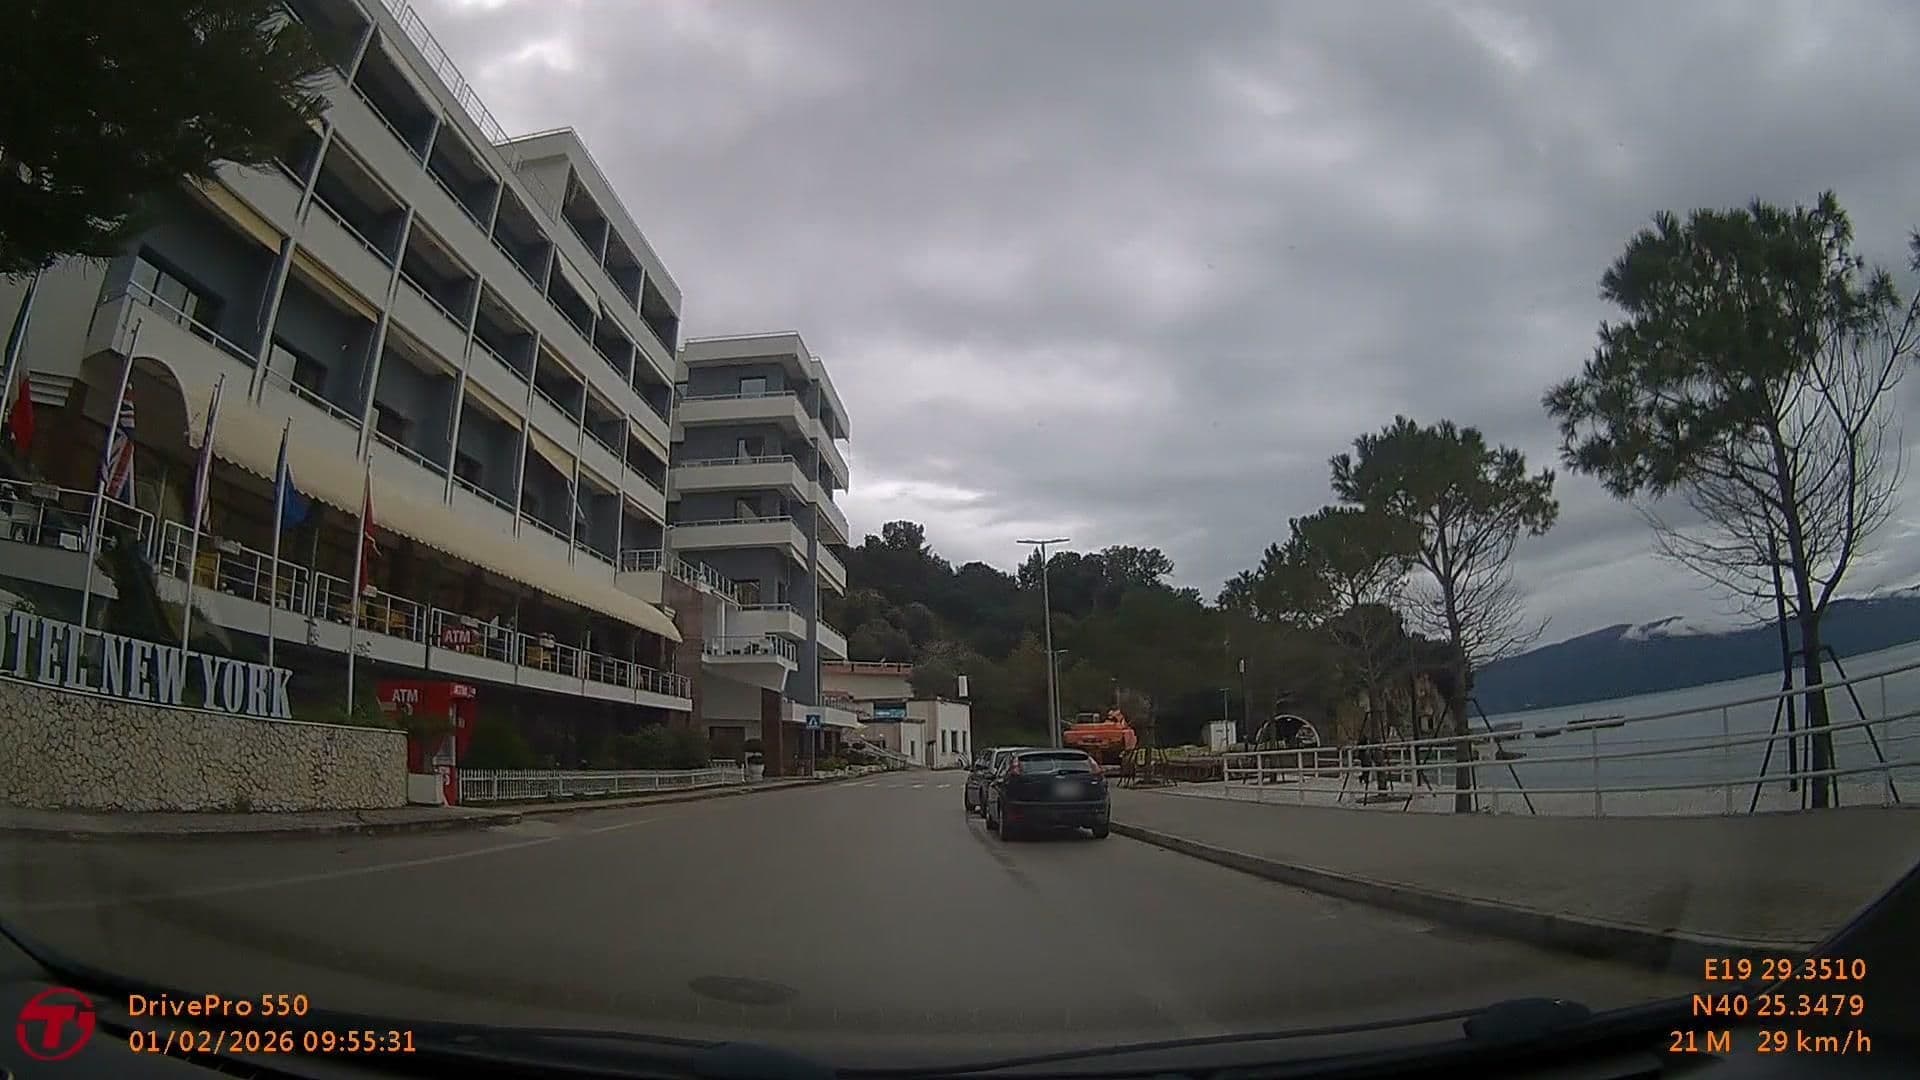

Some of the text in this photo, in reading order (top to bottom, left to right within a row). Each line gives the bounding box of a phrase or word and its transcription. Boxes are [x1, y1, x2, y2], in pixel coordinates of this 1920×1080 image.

[444, 629, 471, 643] ATM
[0, 609, 293, 719] TEL NEW YORK
[392, 687, 418, 703] ATM
